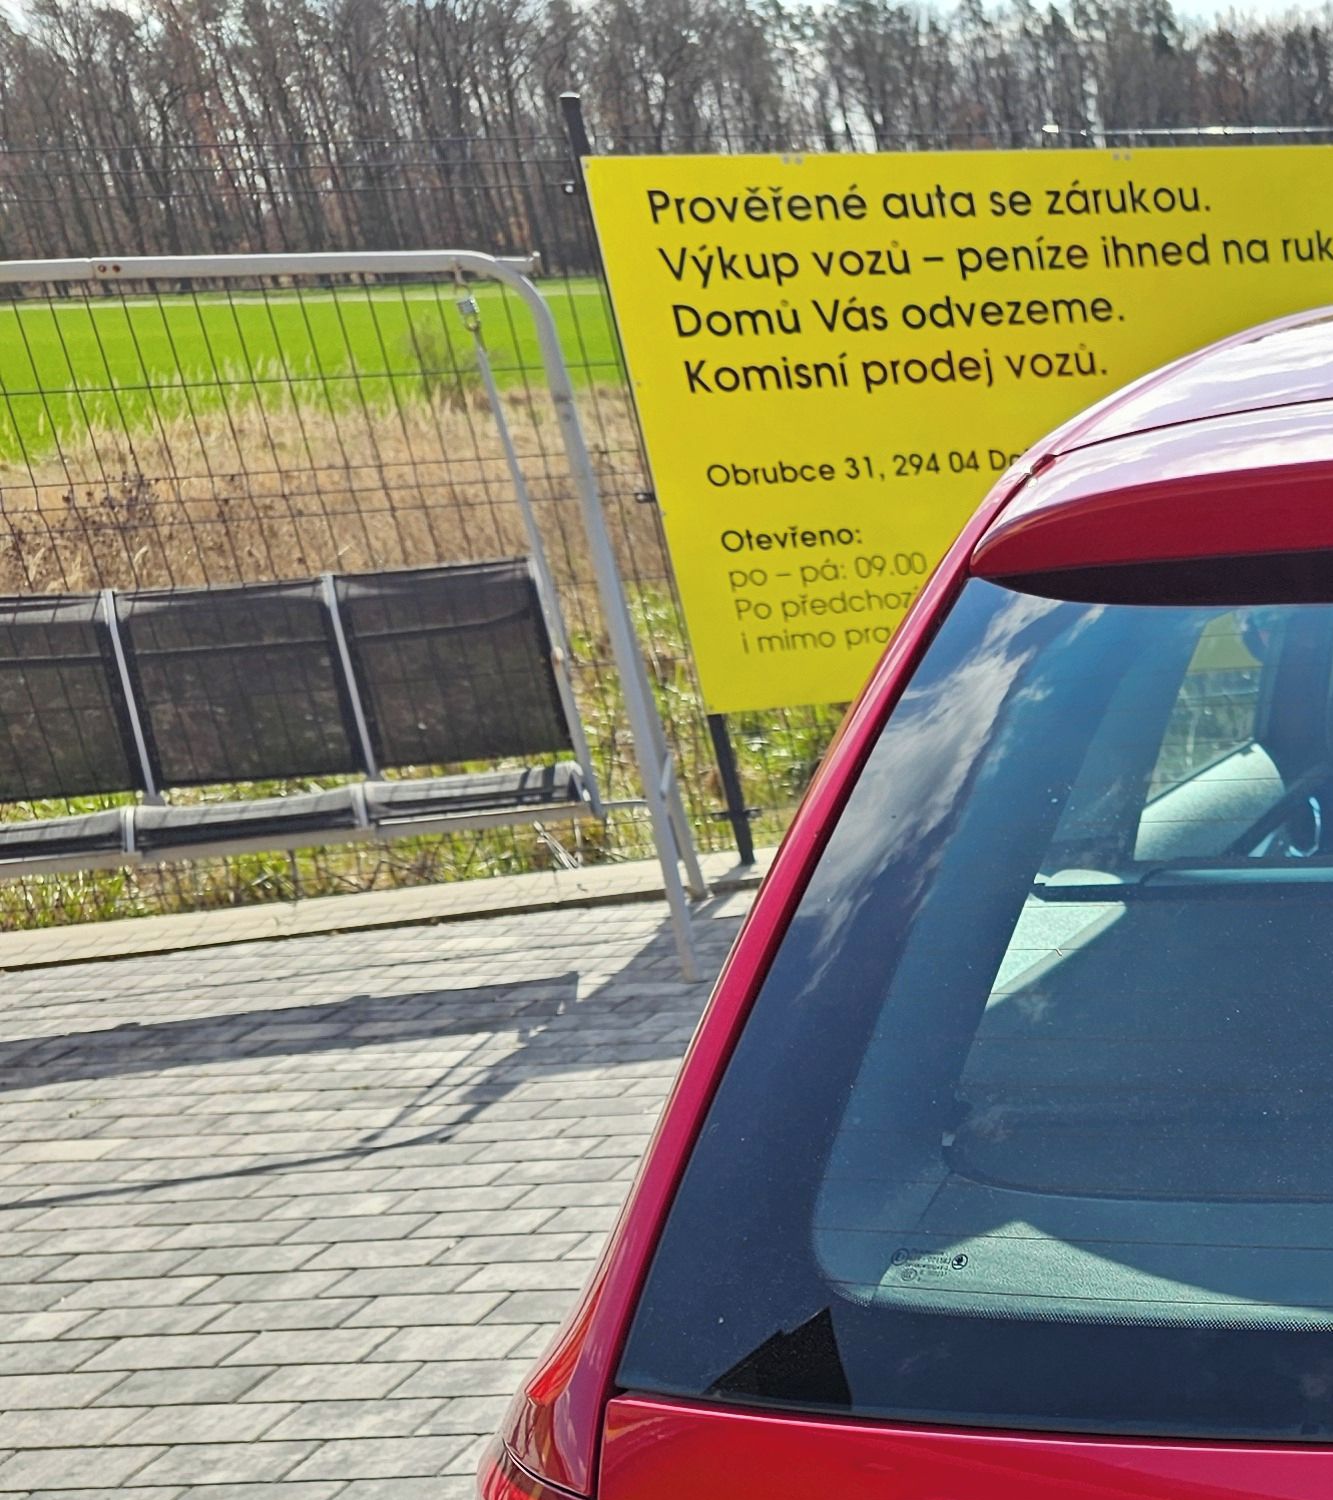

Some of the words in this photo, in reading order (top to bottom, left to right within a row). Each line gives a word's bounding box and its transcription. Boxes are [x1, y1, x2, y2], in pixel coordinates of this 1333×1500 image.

[646, 183, 868, 225] Prověřené
[882, 183, 977, 219] auta
[989, 190, 1032, 217] se
[1045, 179, 1212, 215] zárukou.
[657, 244, 800, 289] Výkup
[811, 239, 912, 277] vozů
[956, 235, 1089, 281] peníze
[1100, 233, 1211, 268] ihned
[1222, 237, 1270, 264] na
[671, 299, 802, 338] Domů
[811, 296, 889, 333] Vás
[901, 294, 1125, 330] odvezeme.
[683, 351, 849, 394] Komisní
[861, 348, 994, 394] prodej
[1004, 342, 1108, 380] vozů.
[706, 460, 836, 487] Obrubce
[845, 455, 885, 481] 31,
[893, 452, 940, 476] 294
[949, 449, 980, 472] 04
[720, 525, 863, 553] Otevřeno:
[728, 568, 768, 592] po
[799, 558, 848, 588] pá:
[854, 551, 928, 579] 09.00
[734, 598, 773, 620] Po
[781, 585, 918, 622] předchoz
[740, 631, 750, 655] i
[756, 628, 837, 653] mimo
[845, 625, 893, 651] pra
